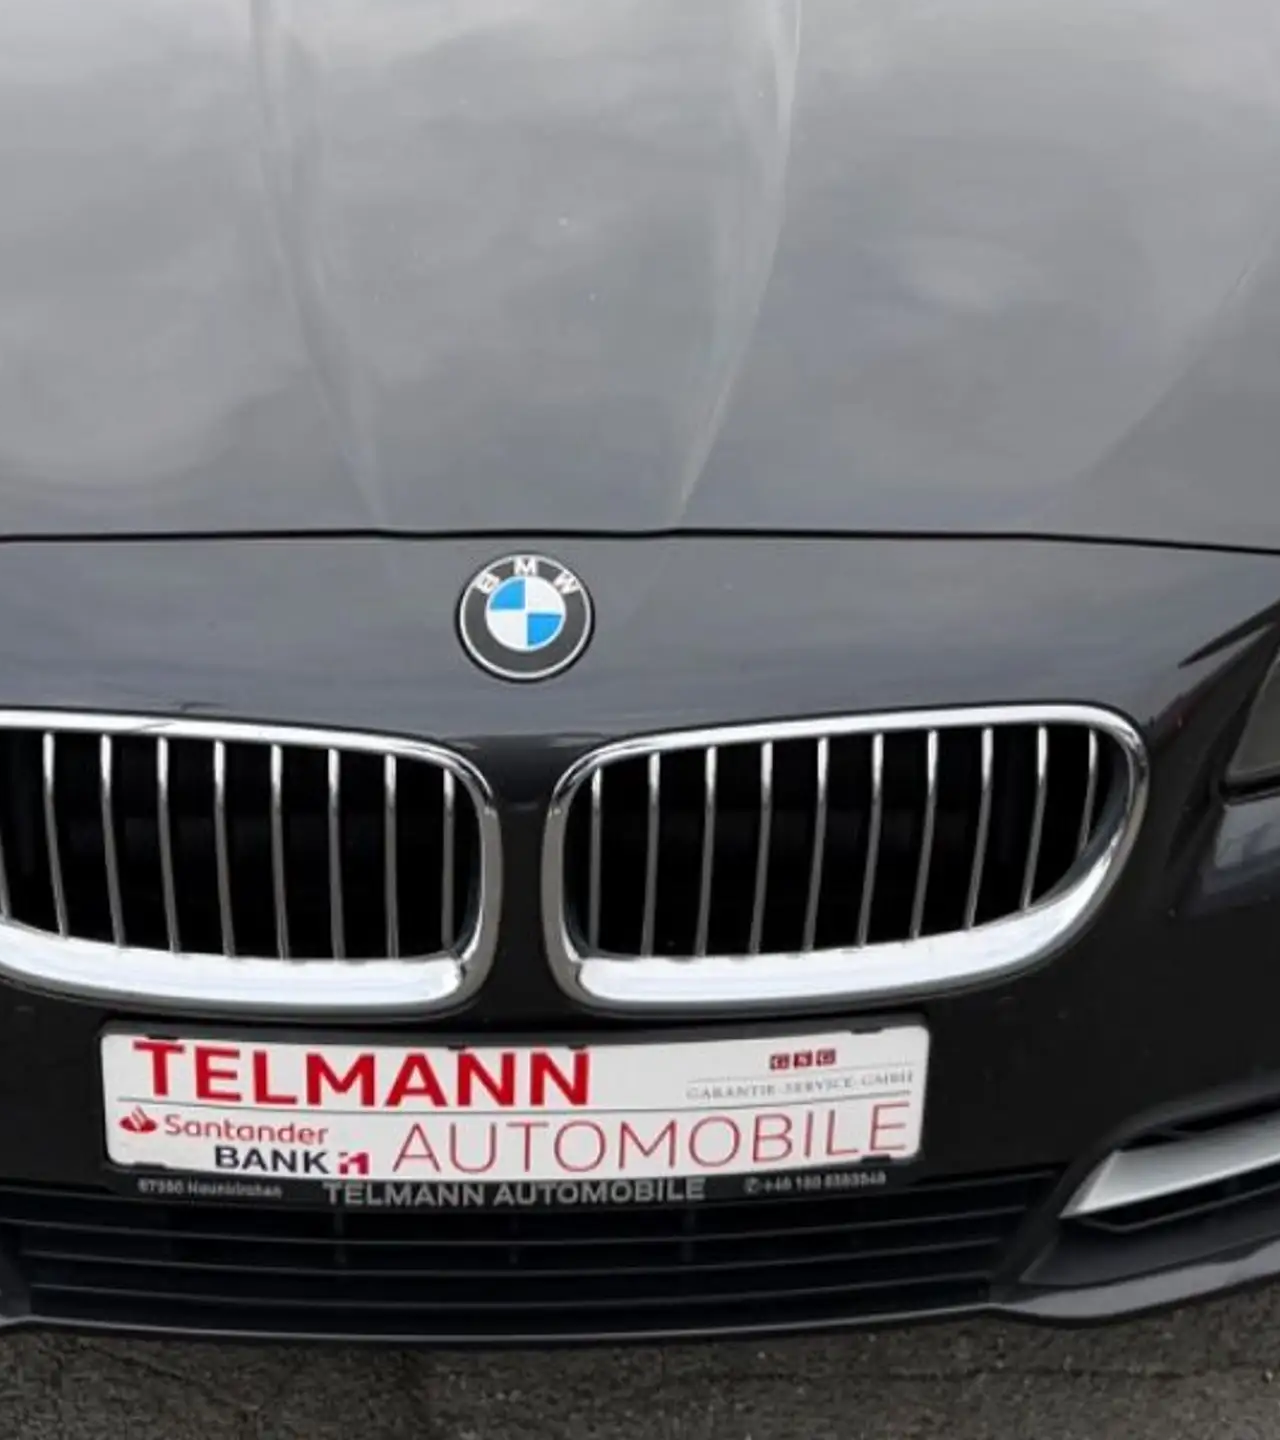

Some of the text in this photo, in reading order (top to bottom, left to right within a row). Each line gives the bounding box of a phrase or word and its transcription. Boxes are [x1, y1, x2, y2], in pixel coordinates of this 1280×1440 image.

[475, 556, 582, 594] BMW
[133, 1040, 589, 1107] TELMANN
[164, 1113, 328, 1145] Santander
[392, 1101, 910, 1173] AUTOMOBILE
[322, 1177, 705, 1206] TELMANN AUTOMOBILE
